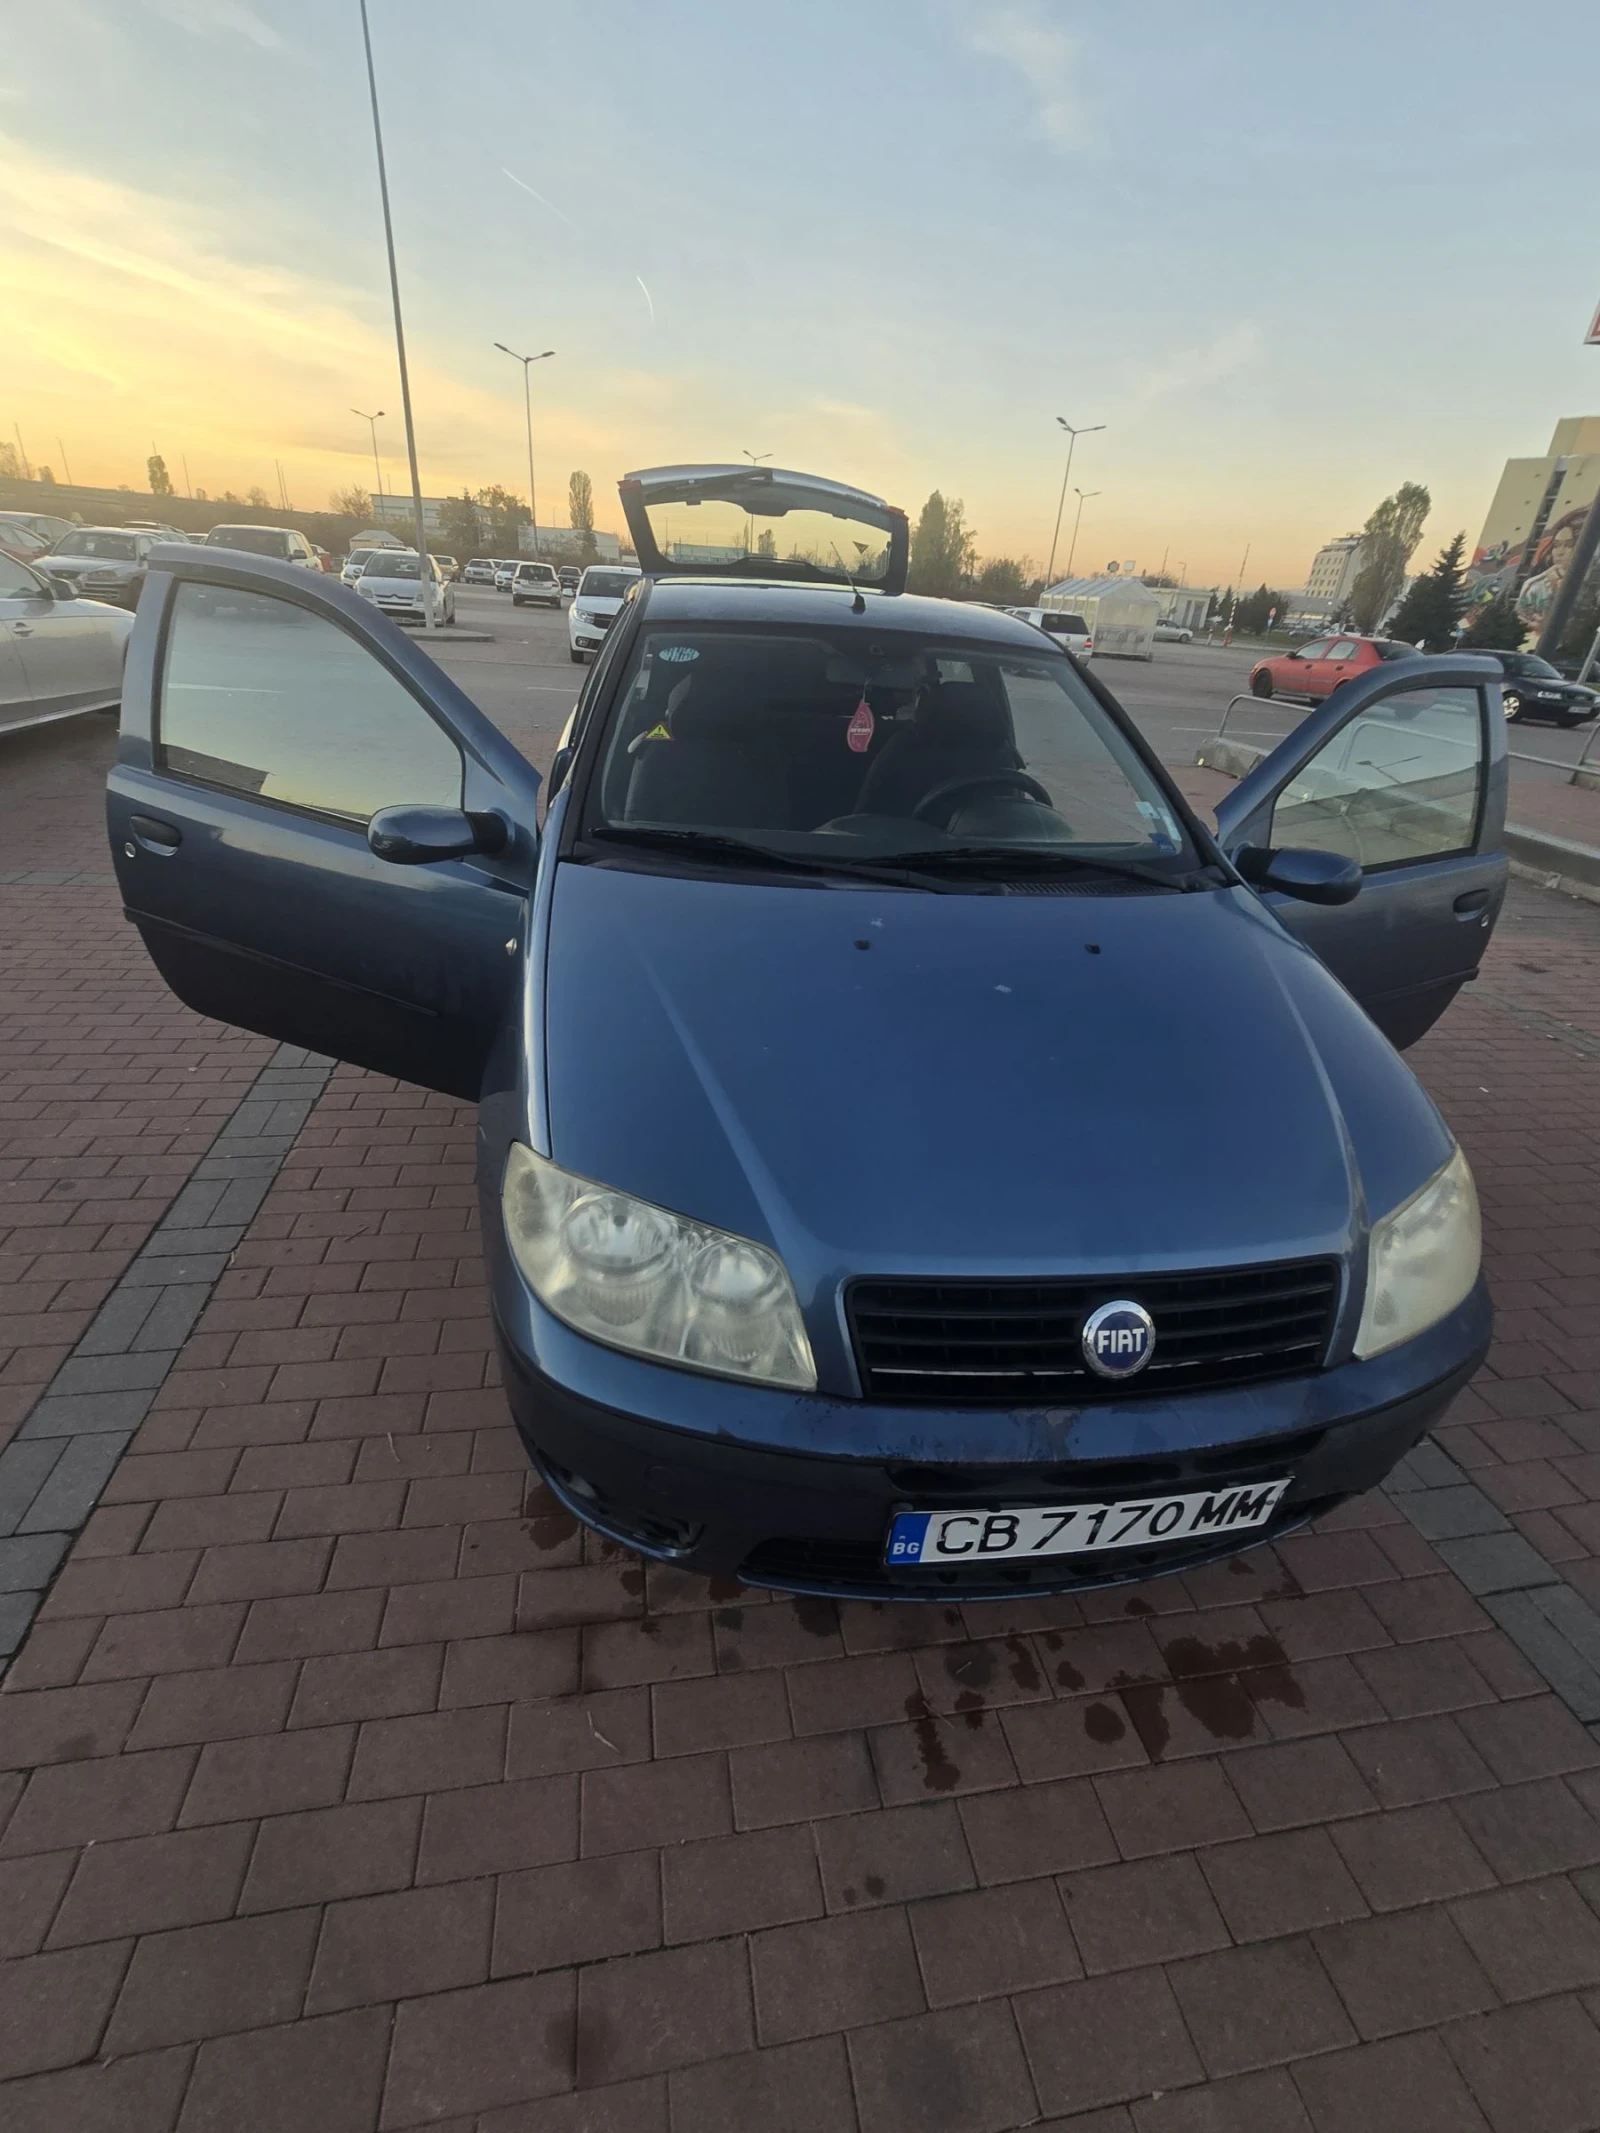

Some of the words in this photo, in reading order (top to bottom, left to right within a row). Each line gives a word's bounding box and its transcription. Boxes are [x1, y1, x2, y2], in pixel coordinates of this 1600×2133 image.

[1097, 1328, 1145, 1354] FIAT
[936, 1516, 1020, 1555] CB
[1031, 1502, 1185, 1550] 7170
[1190, 1486, 1277, 1531] MM
[892, 1542, 920, 1555] BG
